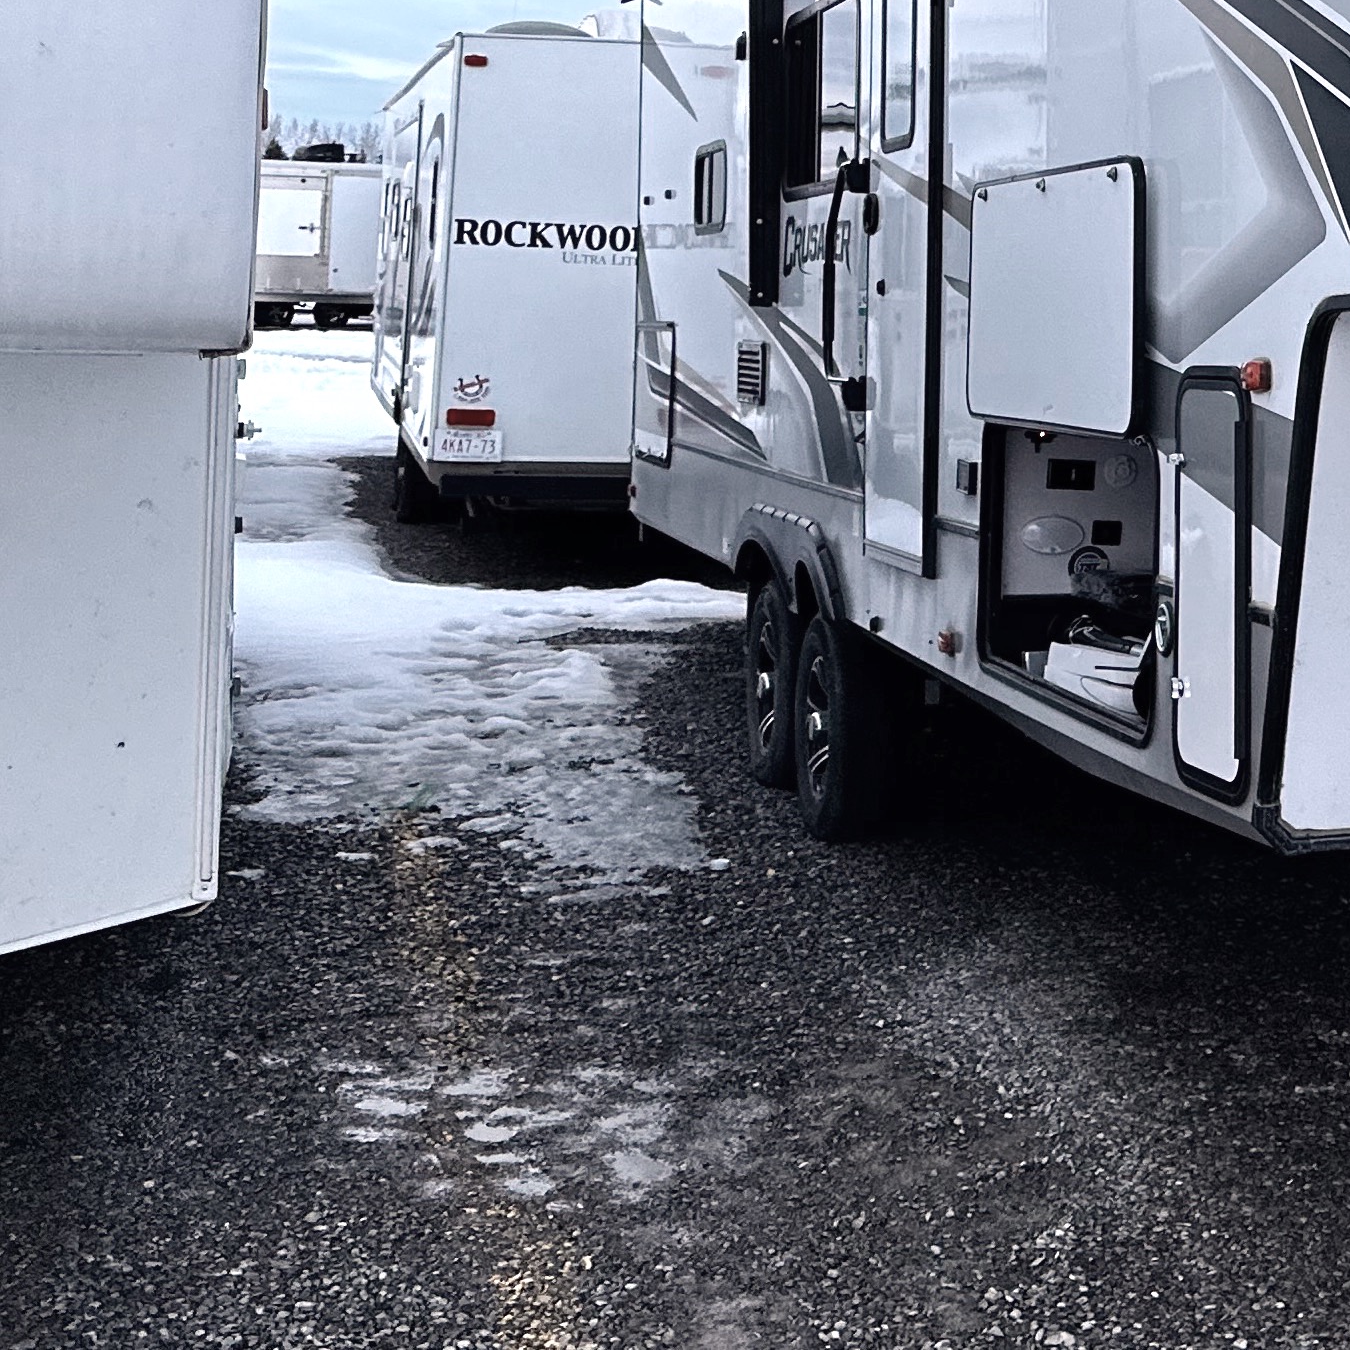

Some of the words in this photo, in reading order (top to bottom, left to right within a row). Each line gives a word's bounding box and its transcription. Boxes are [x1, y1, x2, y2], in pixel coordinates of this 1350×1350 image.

[562, 251, 607, 266] ULTRA
[612, 253, 638, 267] LIT
[783, 215, 852, 278] CRUSAER
